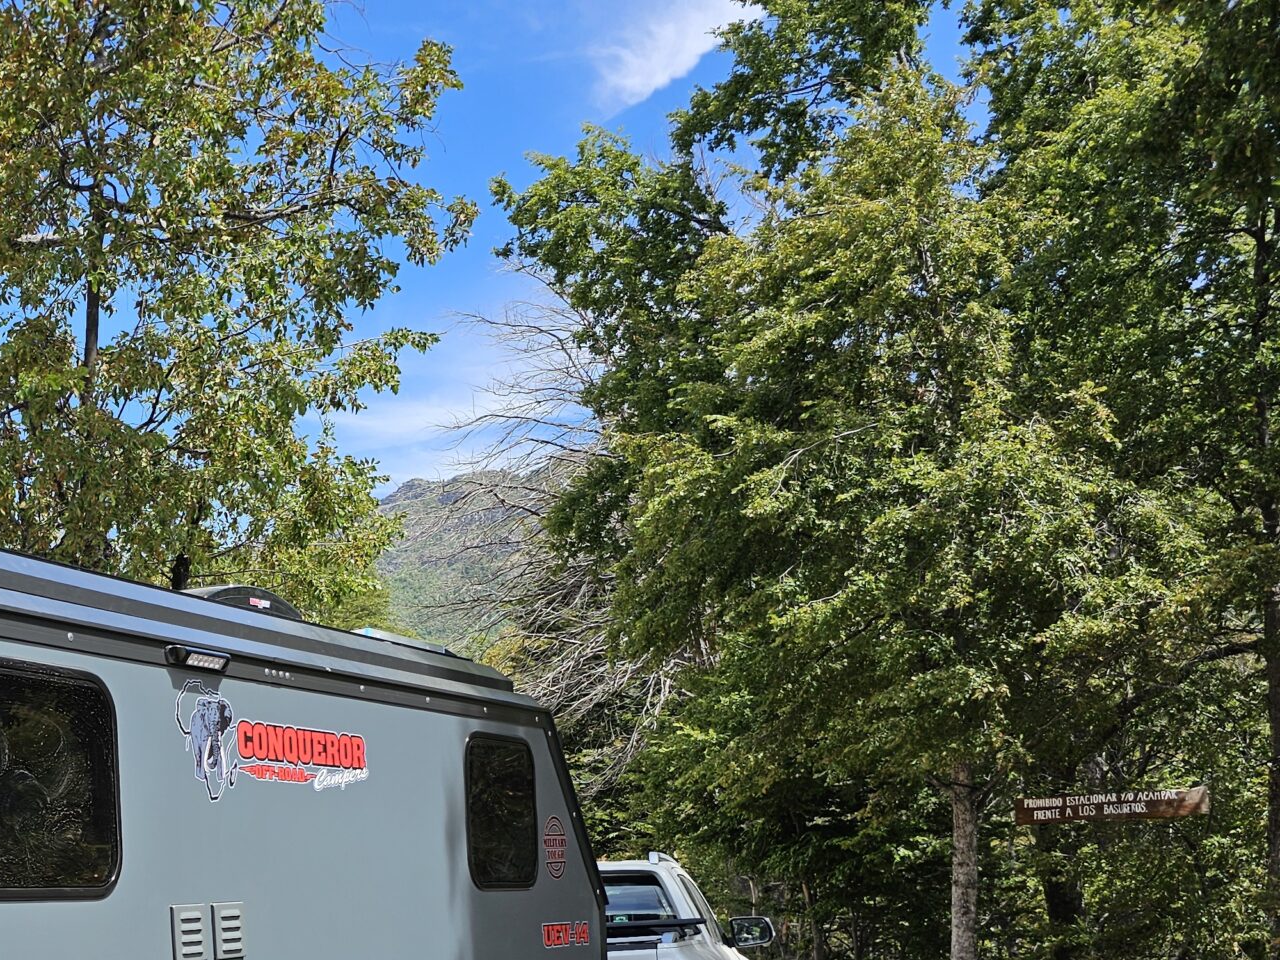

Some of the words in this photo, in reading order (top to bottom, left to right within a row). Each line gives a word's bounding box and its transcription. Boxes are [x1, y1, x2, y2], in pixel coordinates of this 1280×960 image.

[237, 720, 367, 770] CONQUEROR
[253, 764, 310, 783] OFF-ROAD
[314, 766, 370, 791] Campers
[1023, 797, 1063, 809] PROHIBIDO
[1066, 793, 1118, 806] ESTACIONAR
[1033, 808, 1061, 820] FRENTE
[1065, 807, 1073, 818] A
[1078, 805, 1096, 816] LOS
[542, 921, 589, 948] UEV-14
